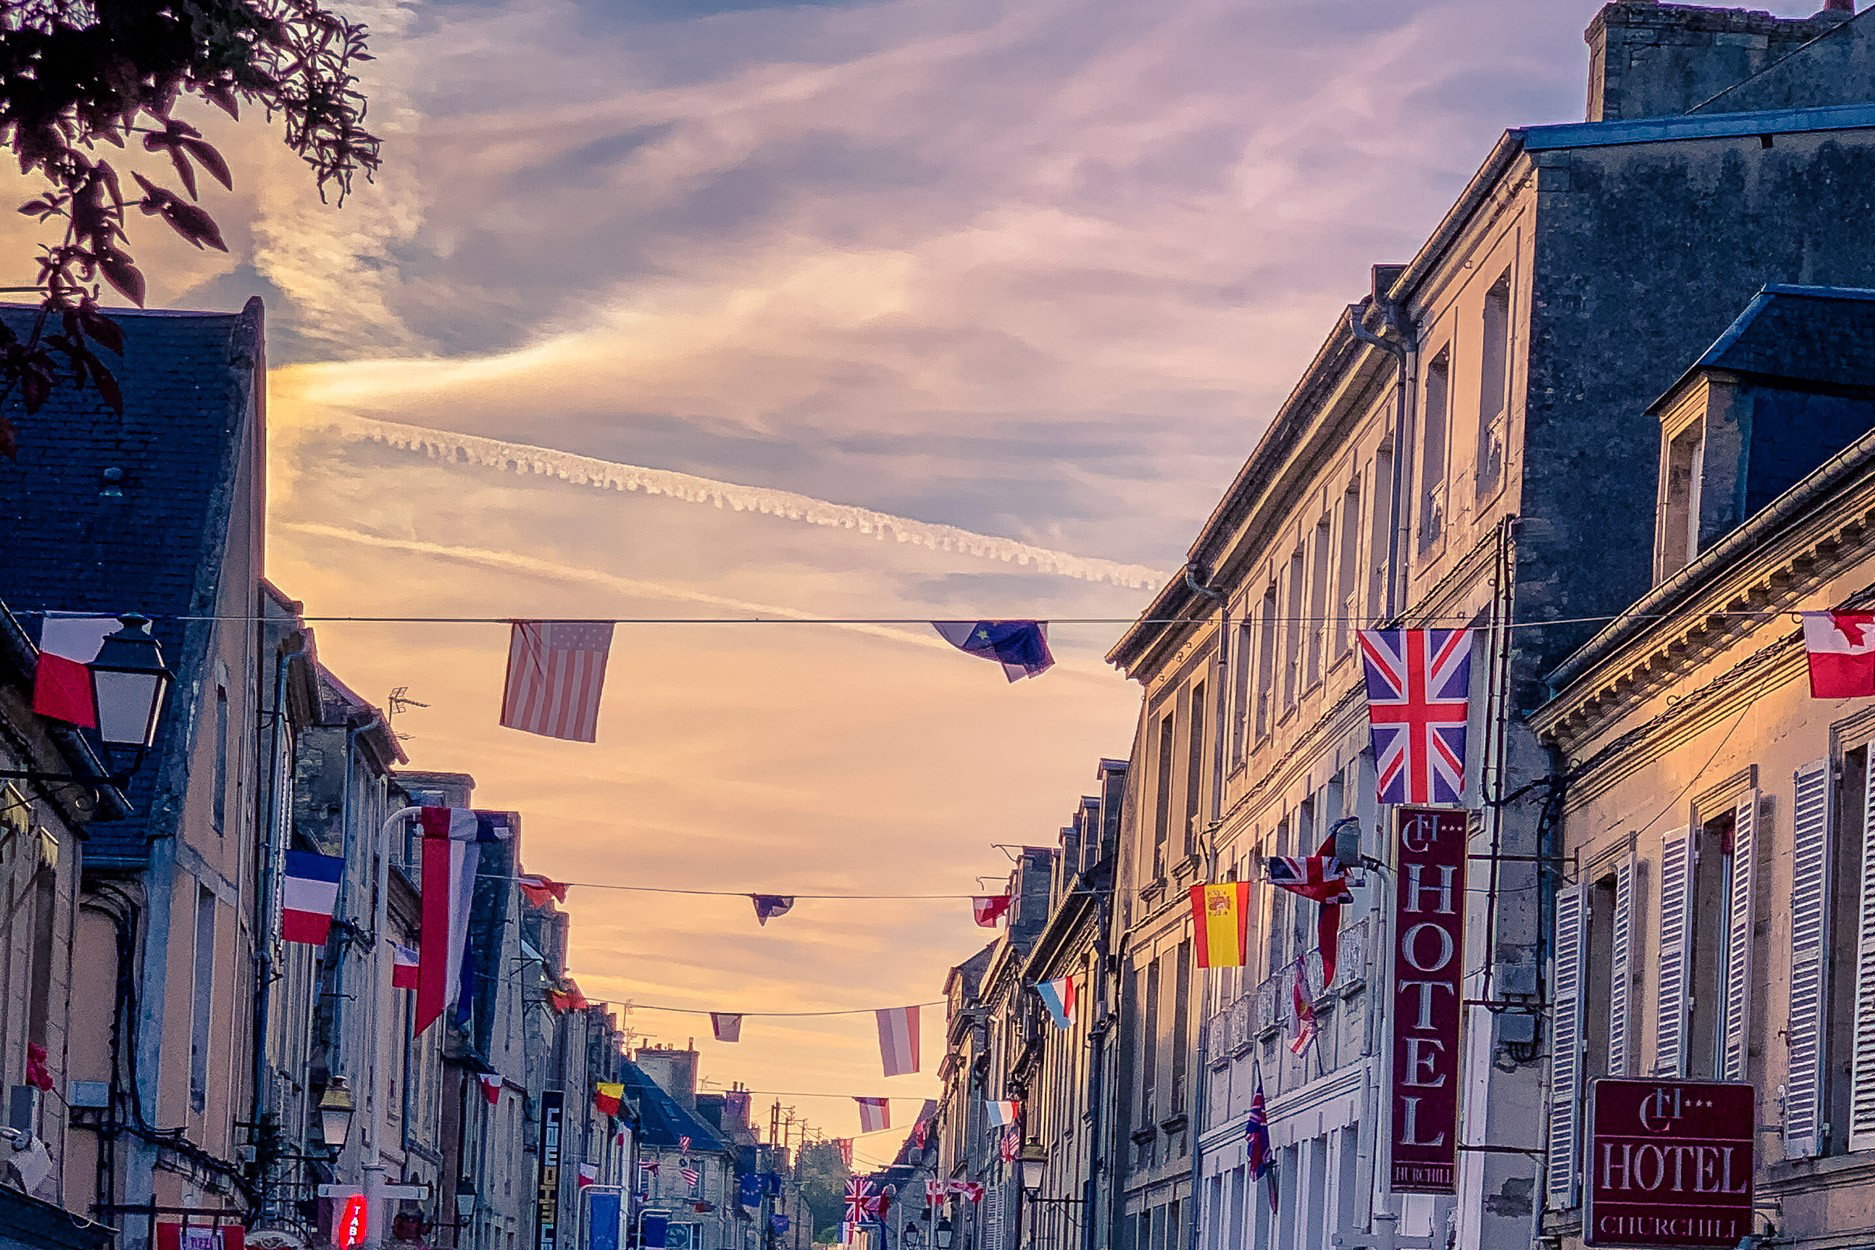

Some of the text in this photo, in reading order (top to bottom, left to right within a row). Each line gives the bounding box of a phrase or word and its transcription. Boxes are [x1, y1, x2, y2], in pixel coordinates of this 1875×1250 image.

[1398, 862, 1457, 1147] HOTEL
[1395, 1167, 1450, 1183] HURCHILL
[1601, 1142, 1748, 1194] HOTEL
[346, 1206, 361, 1246] TABA
[1600, 1215, 1737, 1239] CHURCHILL
